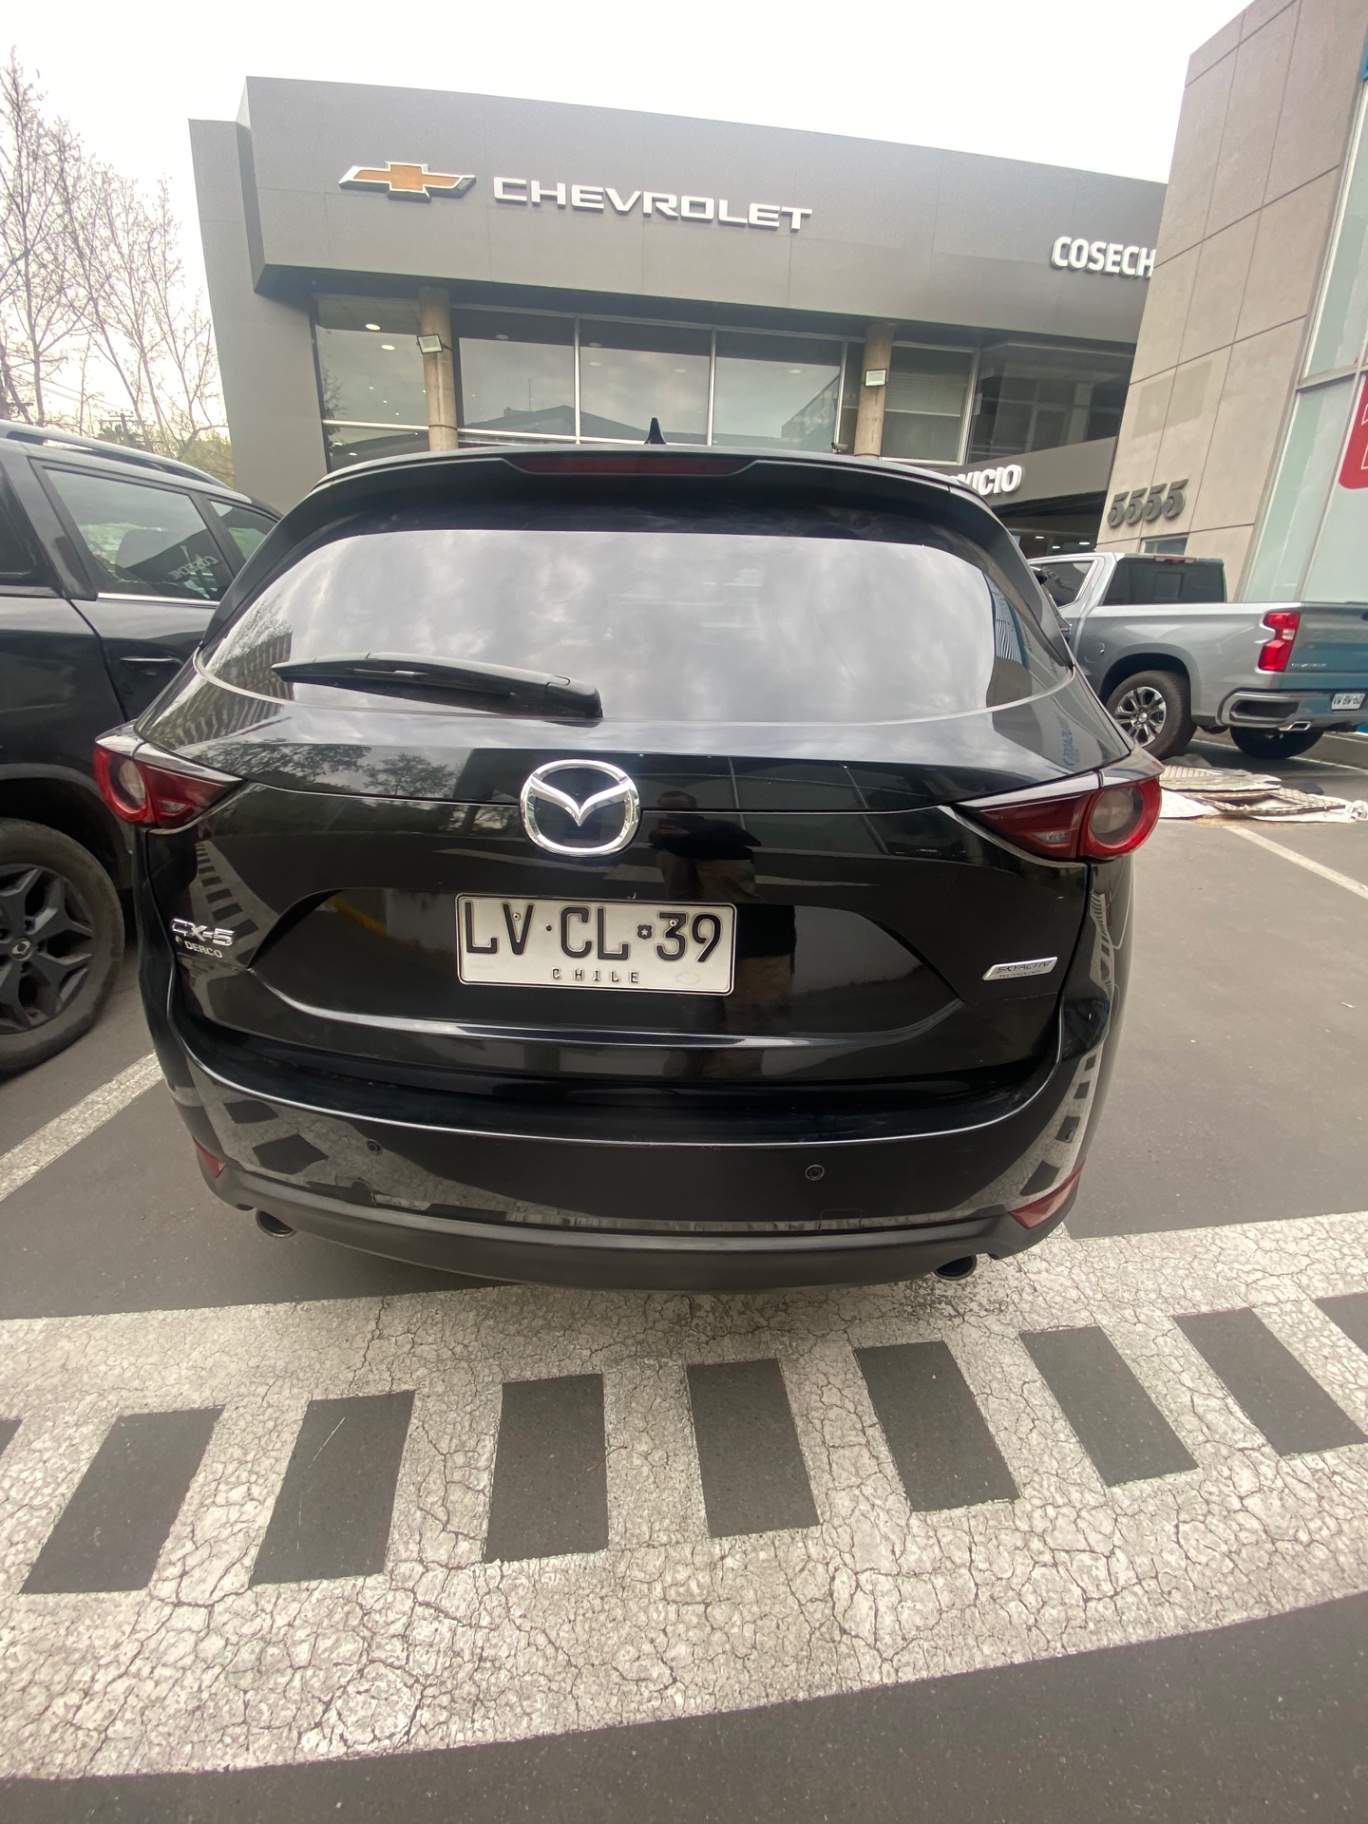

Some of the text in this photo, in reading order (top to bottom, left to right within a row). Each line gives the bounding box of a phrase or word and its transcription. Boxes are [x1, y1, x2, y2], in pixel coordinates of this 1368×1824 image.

[493, 176, 812, 232] CHEVROLET
[1051, 236, 1157, 278] COSECH
[949, 464, 1022, 496] VICIO
[1107, 479, 1189, 528] 5555
[172, 918, 235, 947] CX-5
[184, 940, 223, 959] DERCO
[552, 968, 639, 984] CHILE
